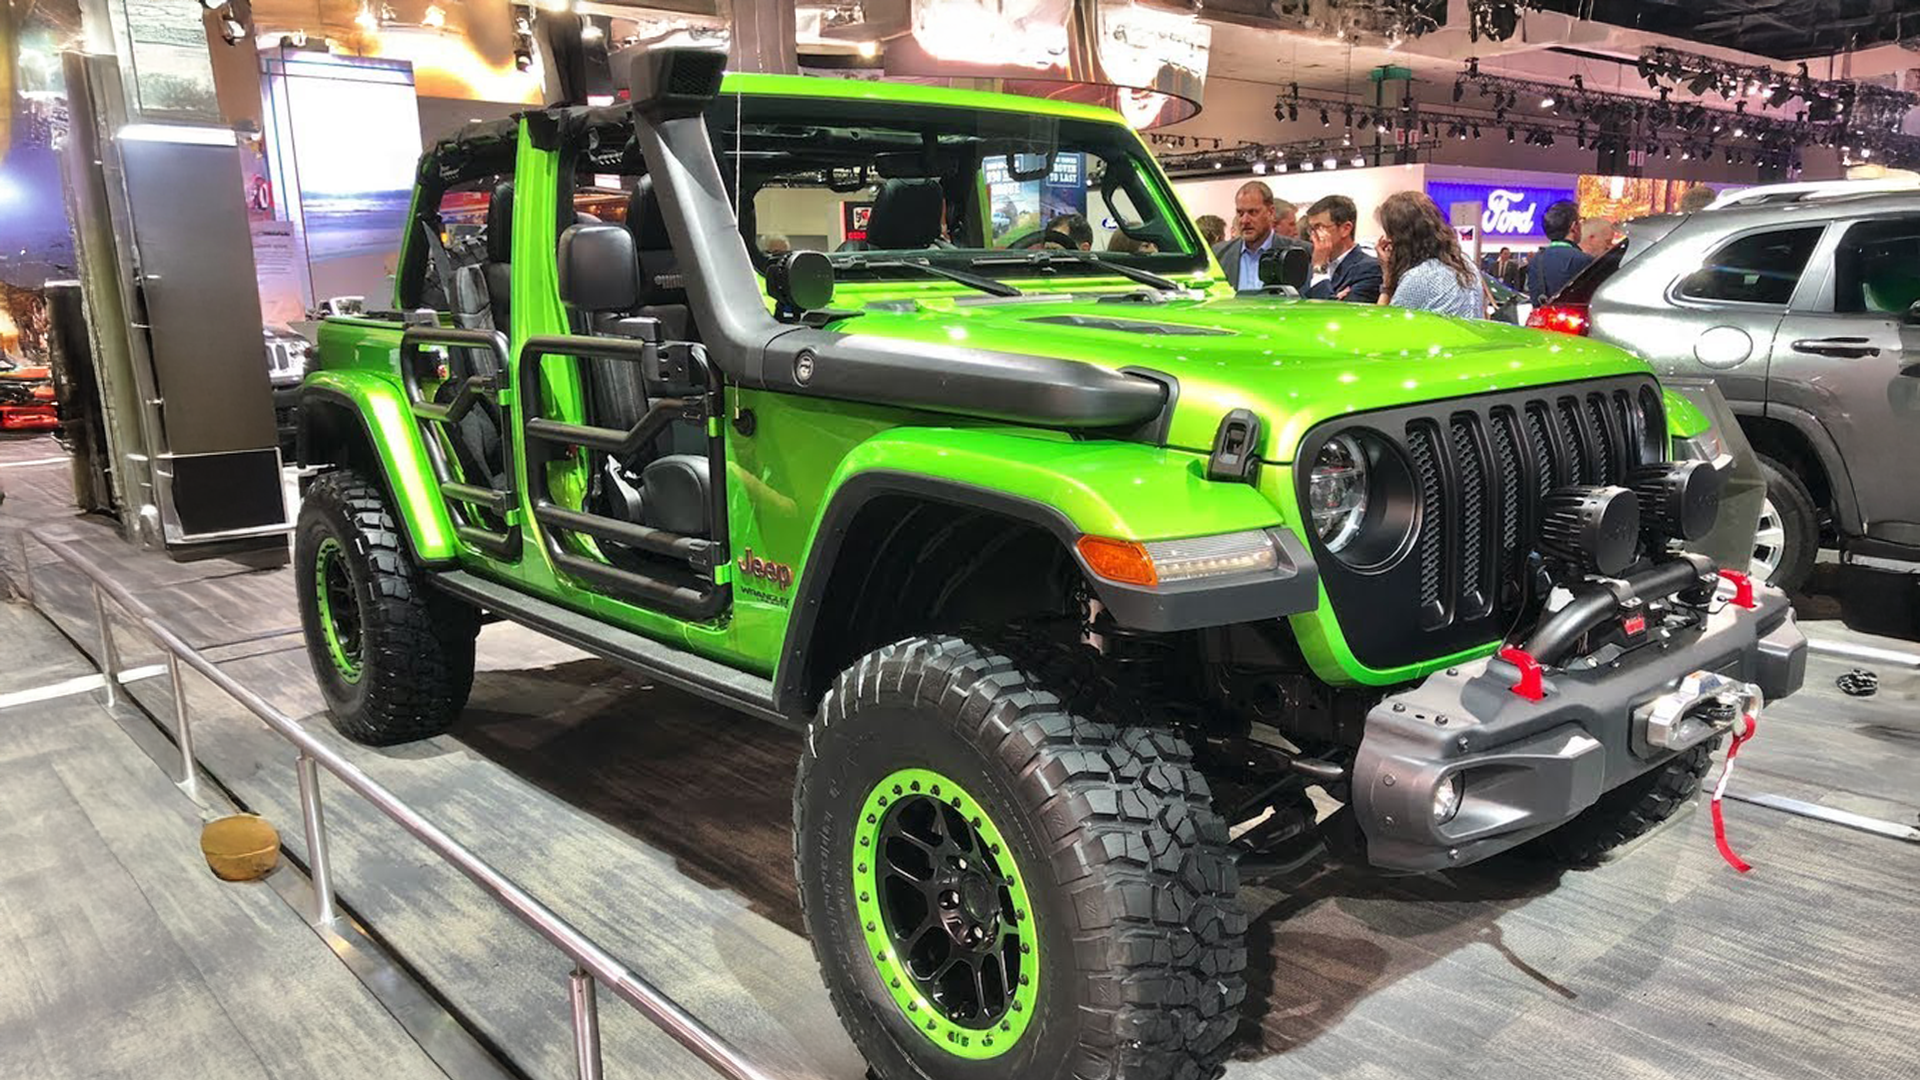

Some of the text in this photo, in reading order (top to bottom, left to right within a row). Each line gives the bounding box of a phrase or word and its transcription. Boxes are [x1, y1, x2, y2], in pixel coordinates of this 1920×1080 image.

[1060, 174, 1077, 183] LAST
[1482, 189, 1536, 234] Ford
[737, 547, 793, 591] Jeep
